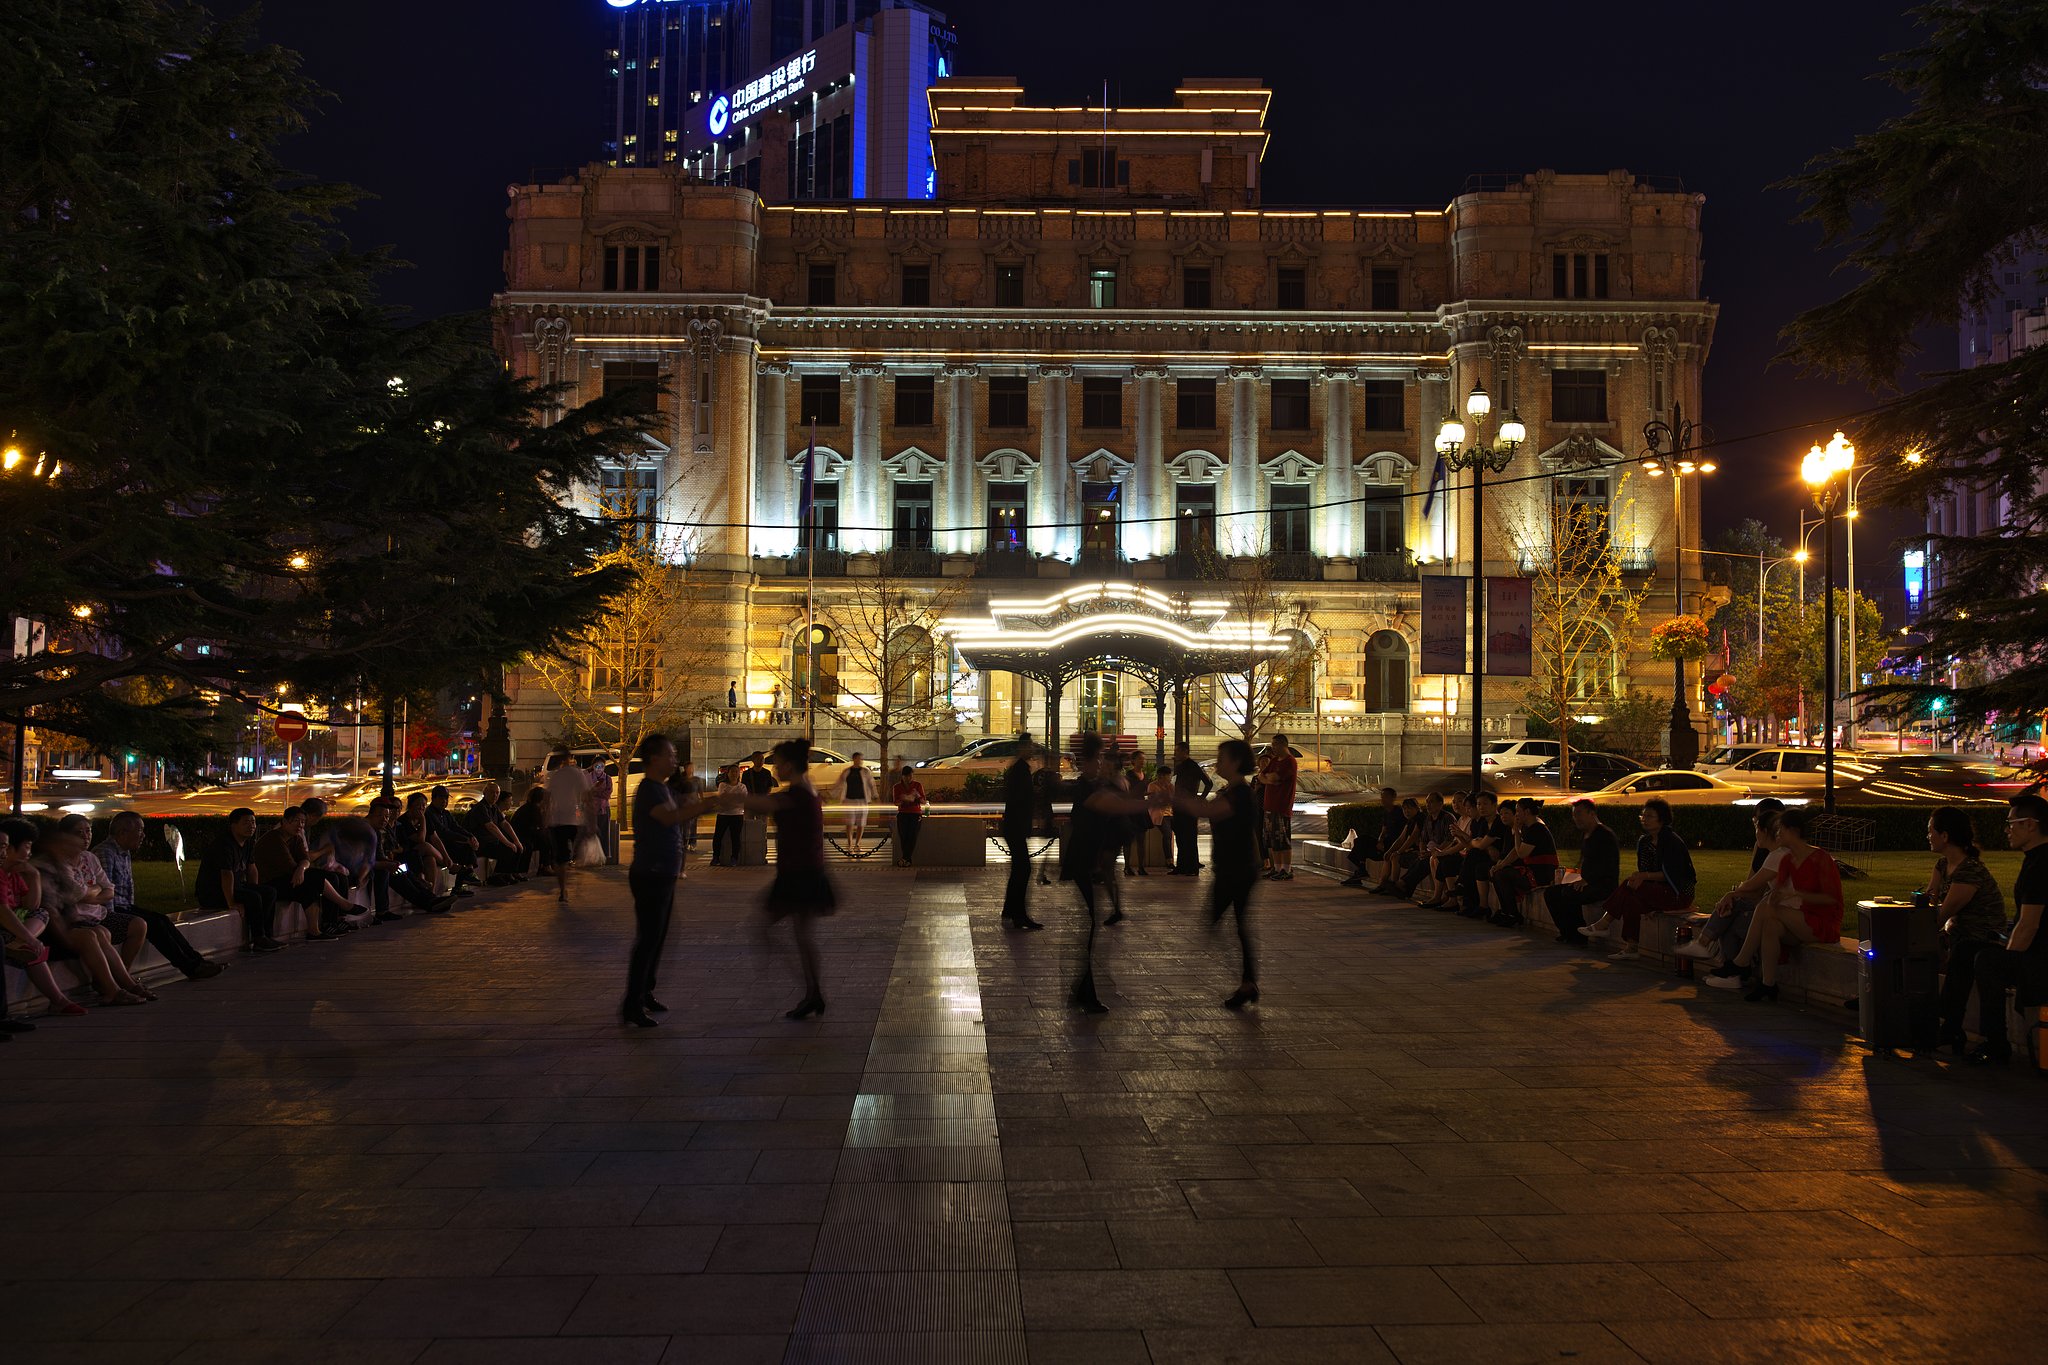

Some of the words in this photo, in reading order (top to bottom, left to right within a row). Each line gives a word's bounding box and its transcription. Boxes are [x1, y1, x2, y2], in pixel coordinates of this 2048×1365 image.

[732, 49, 816, 109] 中国建设银行
[732, 105, 749, 124] China
[788, 78, 805, 96] Bank
